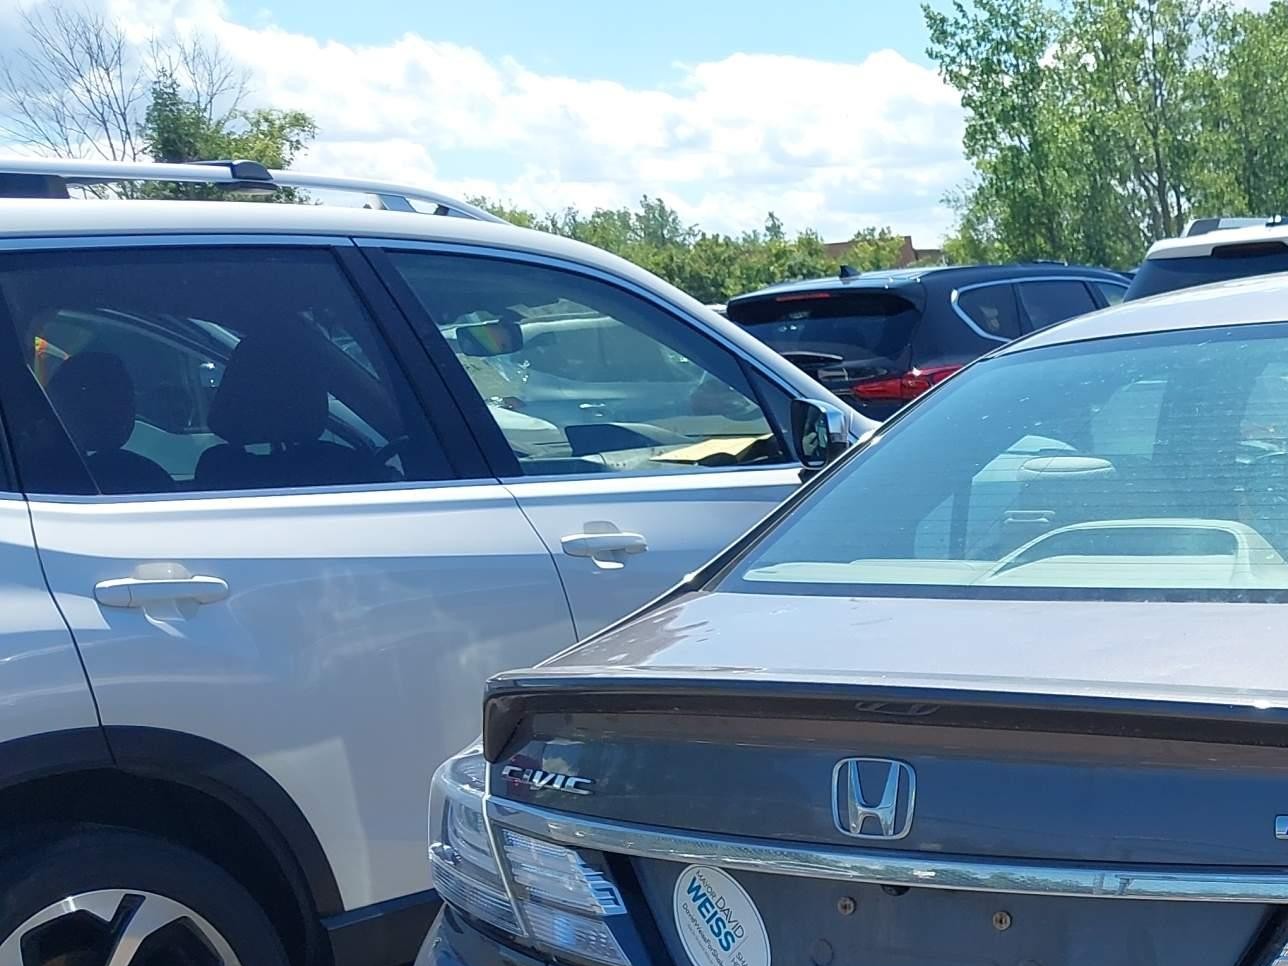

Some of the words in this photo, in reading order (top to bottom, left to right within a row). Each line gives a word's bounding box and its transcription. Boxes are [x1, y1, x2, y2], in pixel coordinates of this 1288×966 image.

[502, 765, 592, 795] CIVIC
[687, 876, 736, 952] WEISS
[696, 870, 717, 899] MAYOR
[715, 896, 744, 939] DAVID
